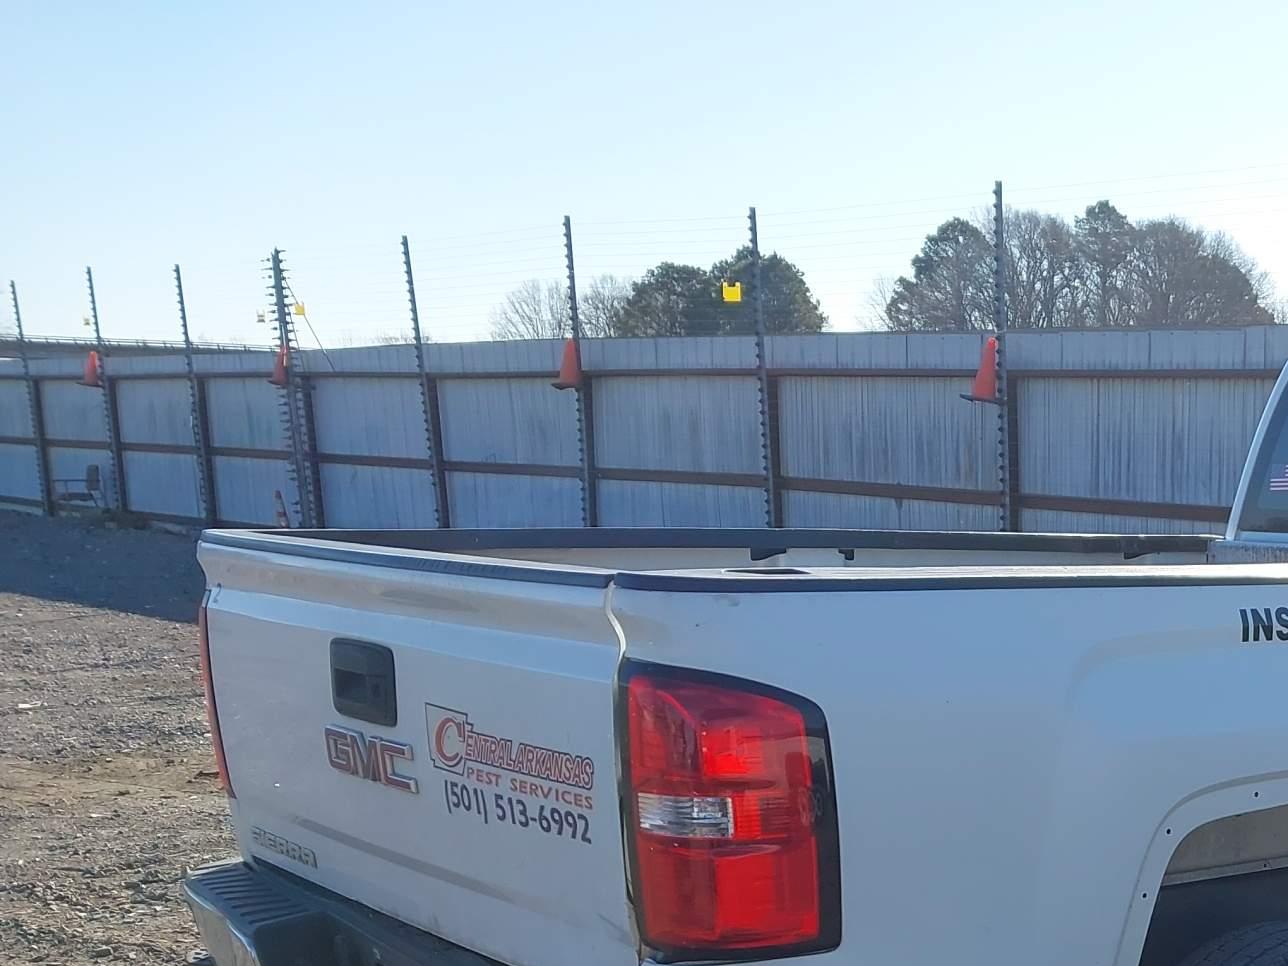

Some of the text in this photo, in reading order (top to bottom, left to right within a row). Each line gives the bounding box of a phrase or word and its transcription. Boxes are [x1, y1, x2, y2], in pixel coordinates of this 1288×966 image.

[324, 723, 419, 794] GMC
[467, 767, 593, 810] PEST SERVICES
[444, 779, 592, 844] (501) 513-6992
